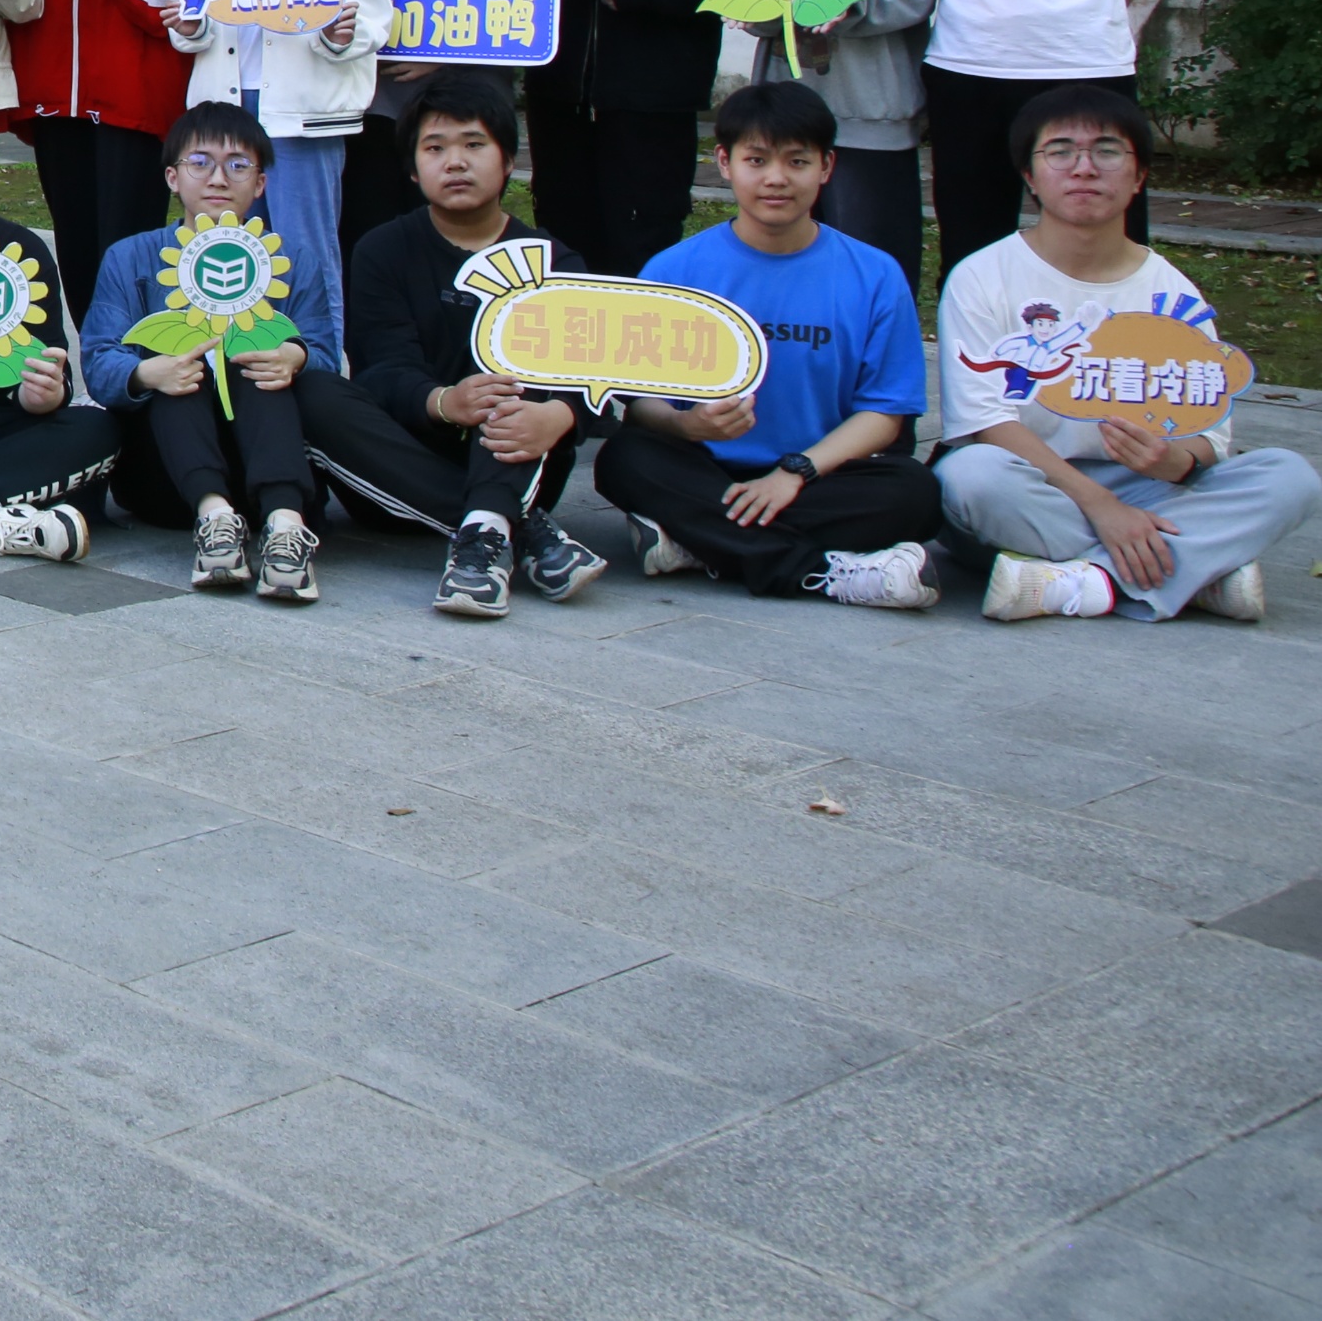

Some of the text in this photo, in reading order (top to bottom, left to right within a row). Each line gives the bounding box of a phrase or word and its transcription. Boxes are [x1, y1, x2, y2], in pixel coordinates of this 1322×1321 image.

[510, 302, 717, 372] 马到成功
[762, 321, 832, 350] ssup
[1070, 357, 1226, 406] 沉着冷静
